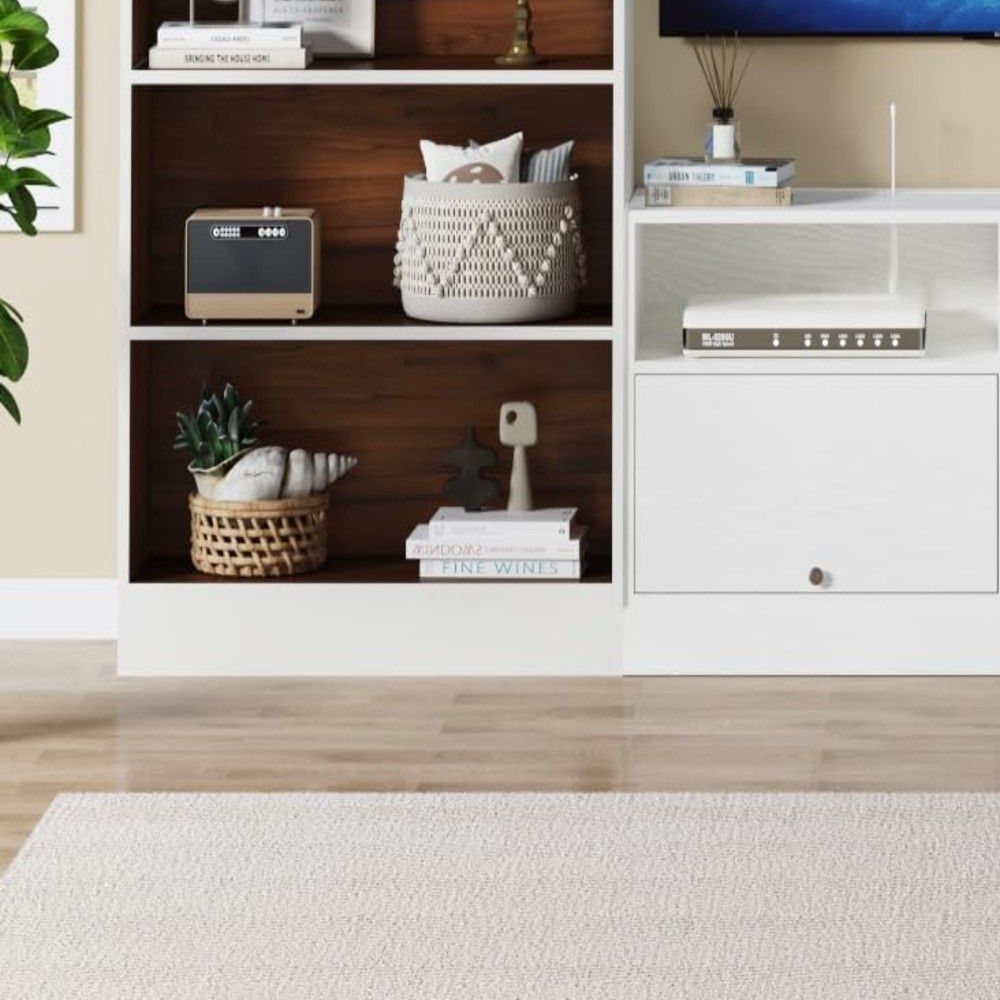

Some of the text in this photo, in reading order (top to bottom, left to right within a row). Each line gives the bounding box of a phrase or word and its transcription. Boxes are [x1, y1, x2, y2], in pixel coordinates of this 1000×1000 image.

[184, 54, 215, 63] BRINGING
[216, 54, 229, 63] THE
[442, 561, 559, 575] FINE WINES
